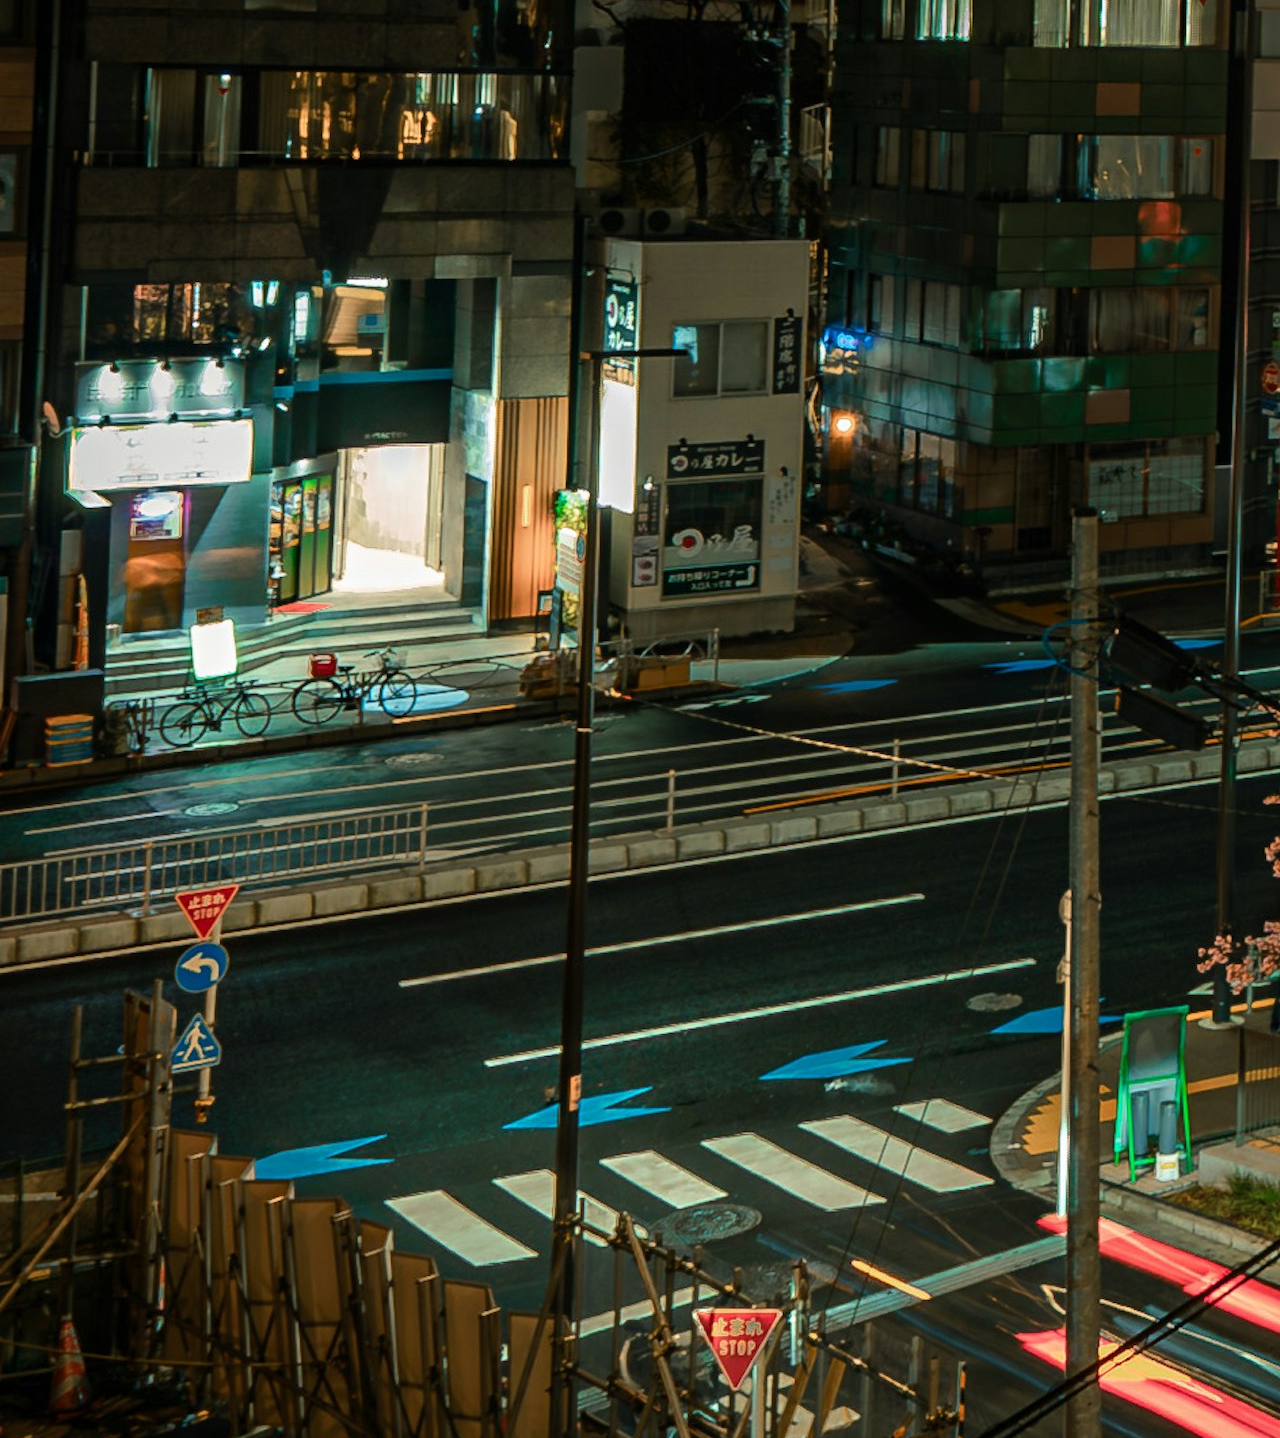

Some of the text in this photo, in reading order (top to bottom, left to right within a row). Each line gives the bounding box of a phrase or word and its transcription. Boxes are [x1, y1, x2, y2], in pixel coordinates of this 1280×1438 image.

[608, 331, 634, 350] カレー
[188, 892, 226, 909] 止まれ
[193, 906, 221, 921] STOP
[711, 1317, 763, 1336] 止まれ
[720, 1339, 756, 1356] STOP
